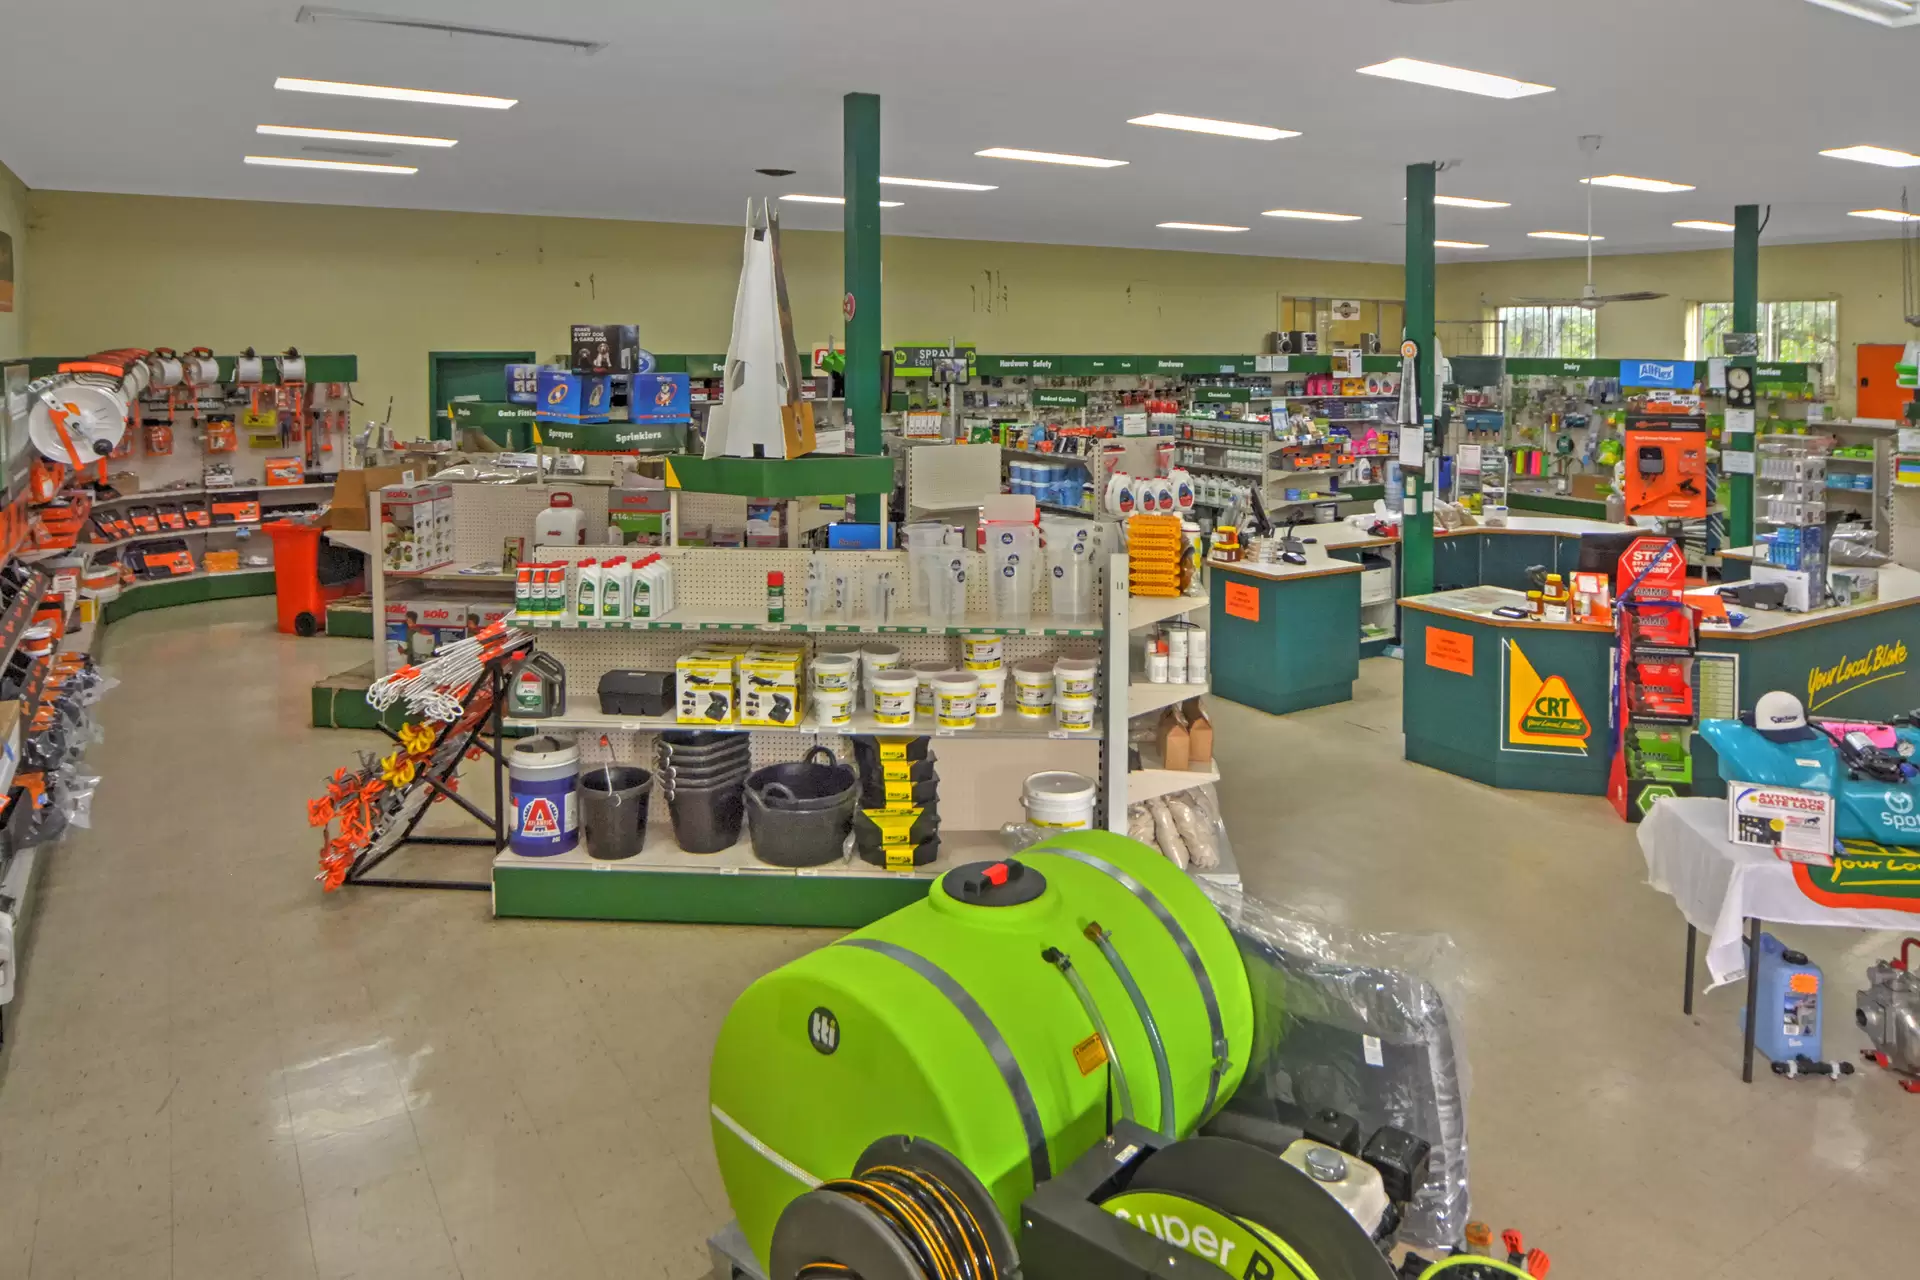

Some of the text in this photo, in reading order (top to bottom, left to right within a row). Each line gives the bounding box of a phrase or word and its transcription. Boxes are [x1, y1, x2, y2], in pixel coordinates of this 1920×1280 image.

[1000, 359, 1052, 369] Hardware Safety
[1158, 360, 1184, 368] Hardware
[1563, 363, 1580, 373] Dairy
[548, 429, 574, 440] Sprayers
[615, 430, 662, 443] Sprinklers
[423, 608, 449, 619] solo
[1808, 639, 1908, 708] Your Local Bloke
[1535, 696, 1570, 717] CRT
[1759, 793, 1825, 805] AUTOMATIC
[1759, 798, 1825, 811] GATE LOCK
[812, 1011, 836, 1049] tti
[1115, 1207, 1236, 1266] uper
